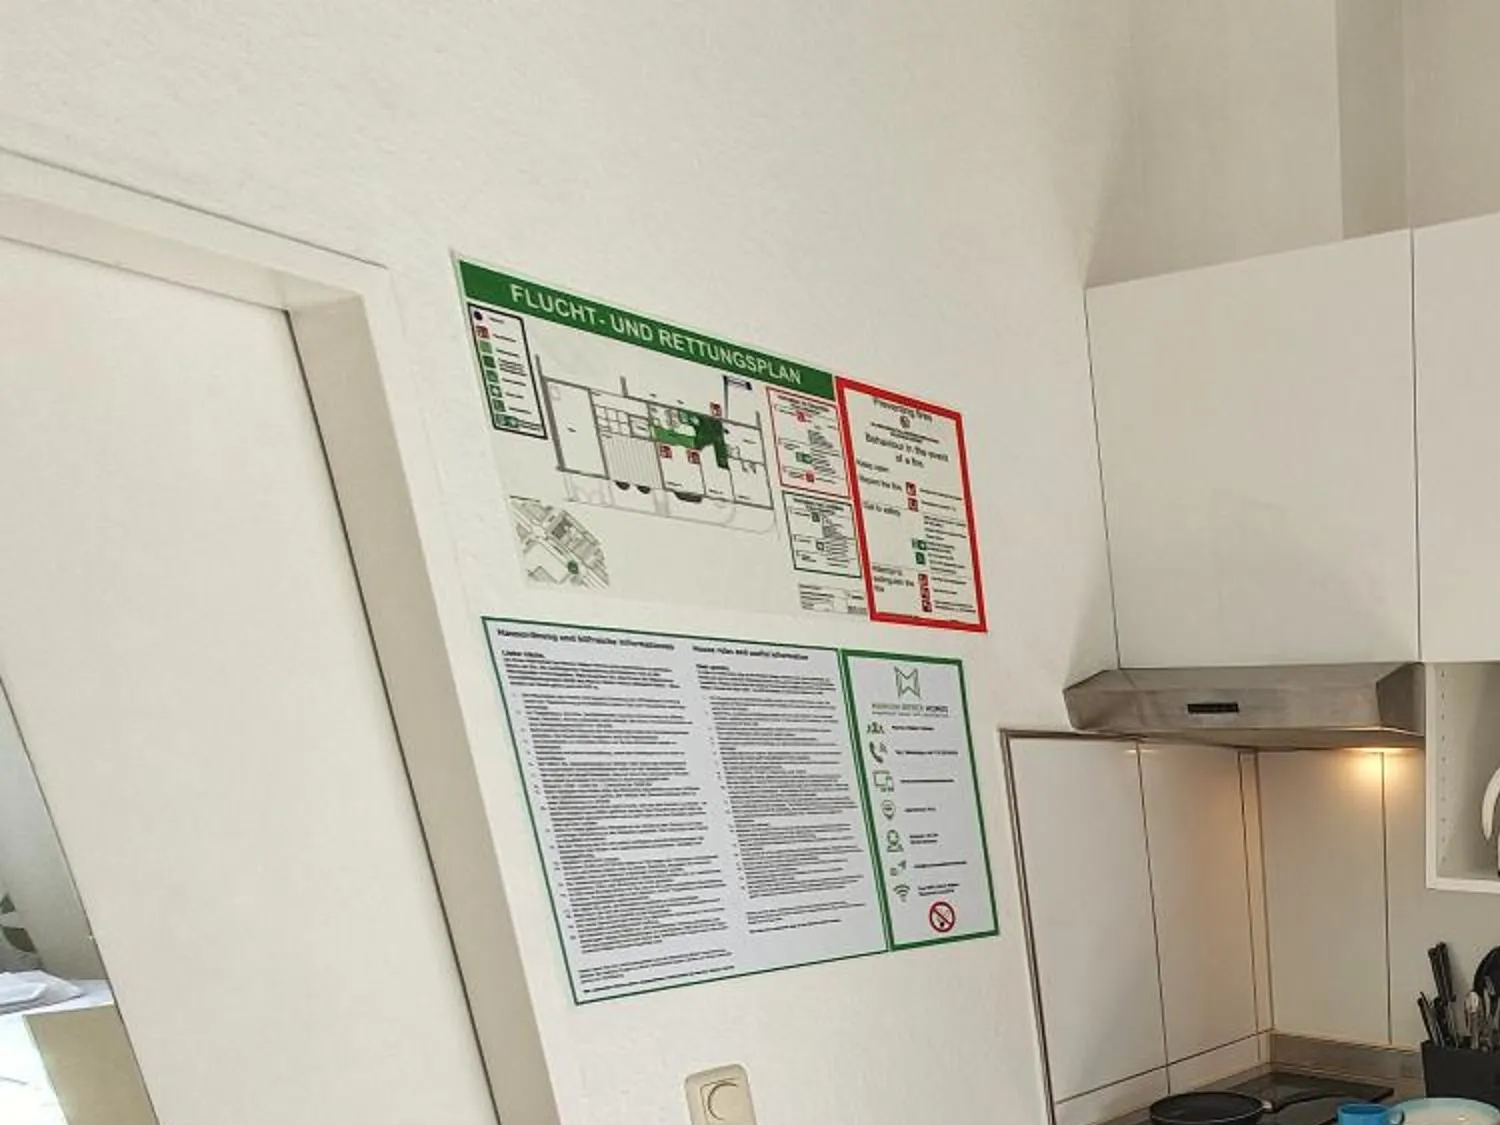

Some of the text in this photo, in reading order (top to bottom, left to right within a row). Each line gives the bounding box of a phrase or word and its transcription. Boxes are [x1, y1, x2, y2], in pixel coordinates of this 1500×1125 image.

[509, 283, 802, 384] FLUCHT- UND RETTUNGSPLAN
